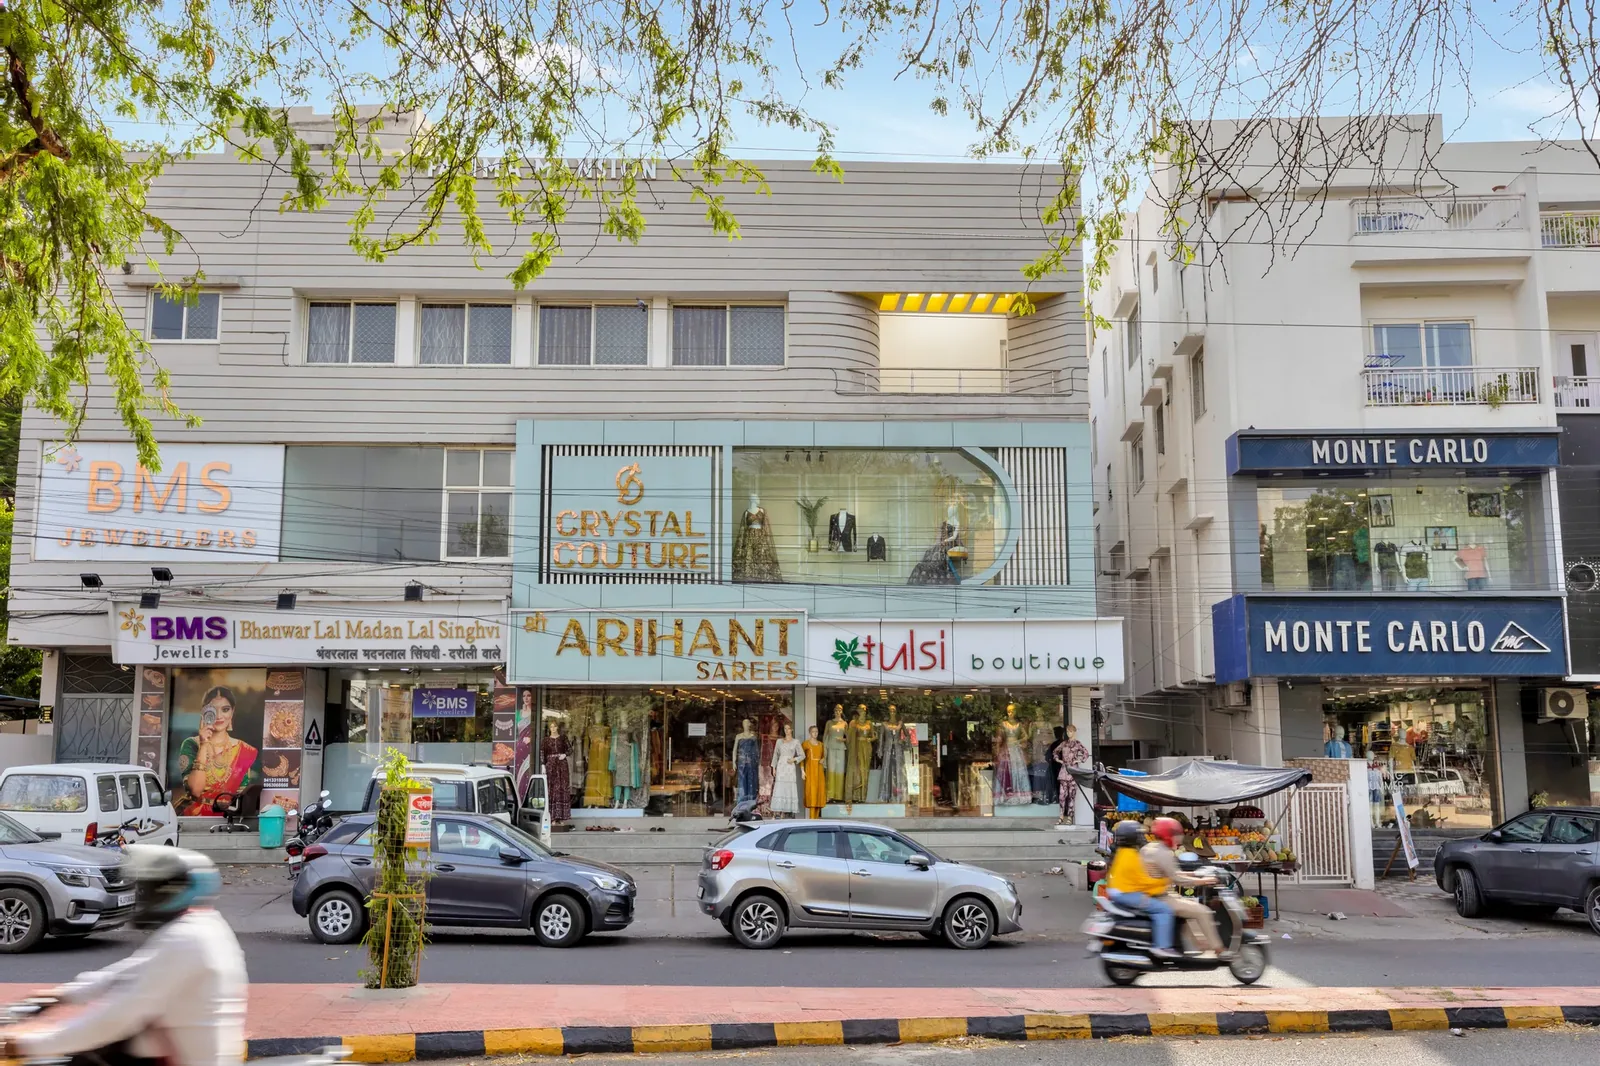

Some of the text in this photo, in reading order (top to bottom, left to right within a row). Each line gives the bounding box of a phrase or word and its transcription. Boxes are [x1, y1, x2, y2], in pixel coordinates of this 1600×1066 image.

[1312, 438, 1488, 465] MONTE CARLO
[86, 460, 233, 514] BMS
[556, 510, 705, 537] CRYSTAL
[58, 528, 258, 548] JEWELLERS
[553, 541, 709, 569] COUTURE
[150, 615, 228, 640] BMS
[240, 618, 500, 645] Bhanwar Lal Madan Lal Singhvi
[556, 618, 799, 657] ARIHANT
[1265, 620, 1372, 654] MONTE
[1387, 620, 1485, 654] CARLO
[153, 645, 229, 662] Jewellers
[362, 648, 406, 660] मदनलाल
[448, 645, 477, 660] दरोली
[482, 645, 501, 660] वाले
[863, 629, 946, 672] tulsi
[971, 652, 1105, 670] boutique
[696, 660, 799, 681] SAREES
[437, 697, 468, 709] BMS
